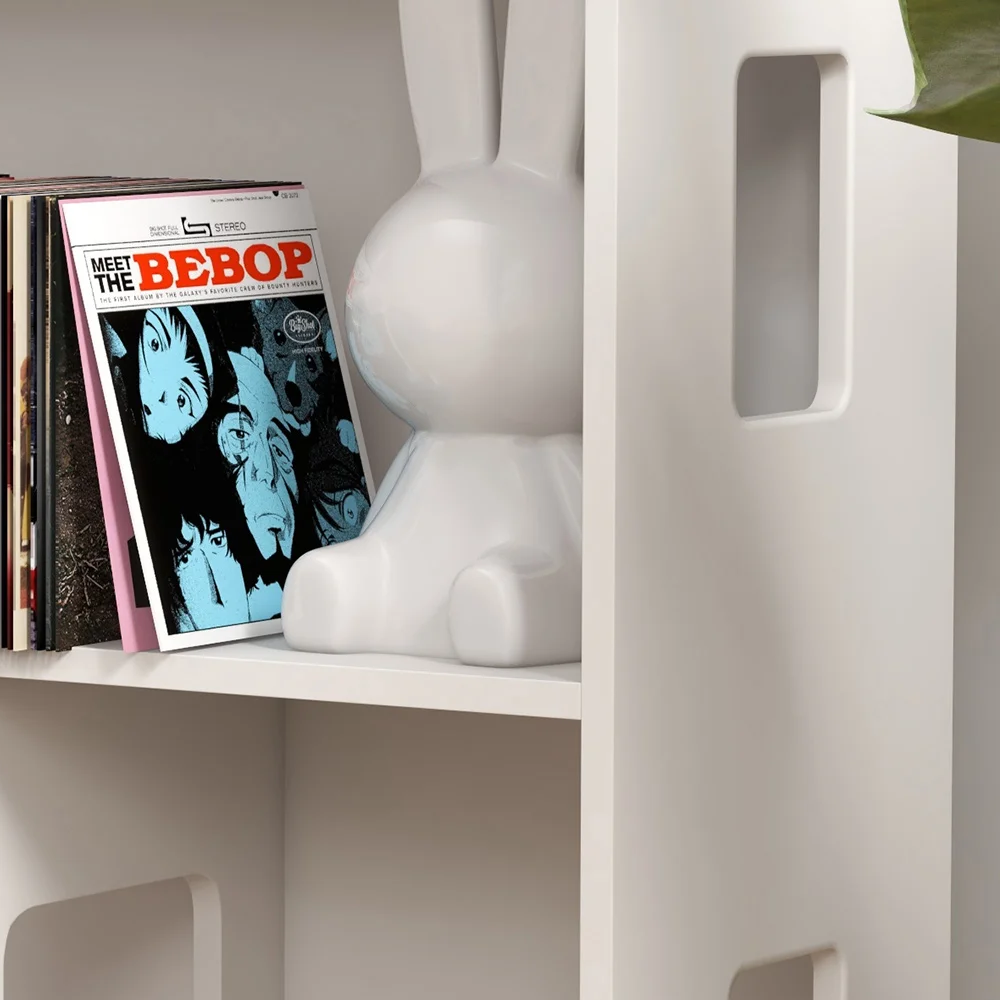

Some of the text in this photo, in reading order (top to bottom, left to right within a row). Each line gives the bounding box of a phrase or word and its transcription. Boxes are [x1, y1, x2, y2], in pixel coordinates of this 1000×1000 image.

[214, 221, 246, 232] STEREO
[90, 255, 131, 272] MEET
[132, 241, 313, 291] BEBOP
[94, 272, 135, 293] THE
[180, 289, 208, 297] GALAXY'S
